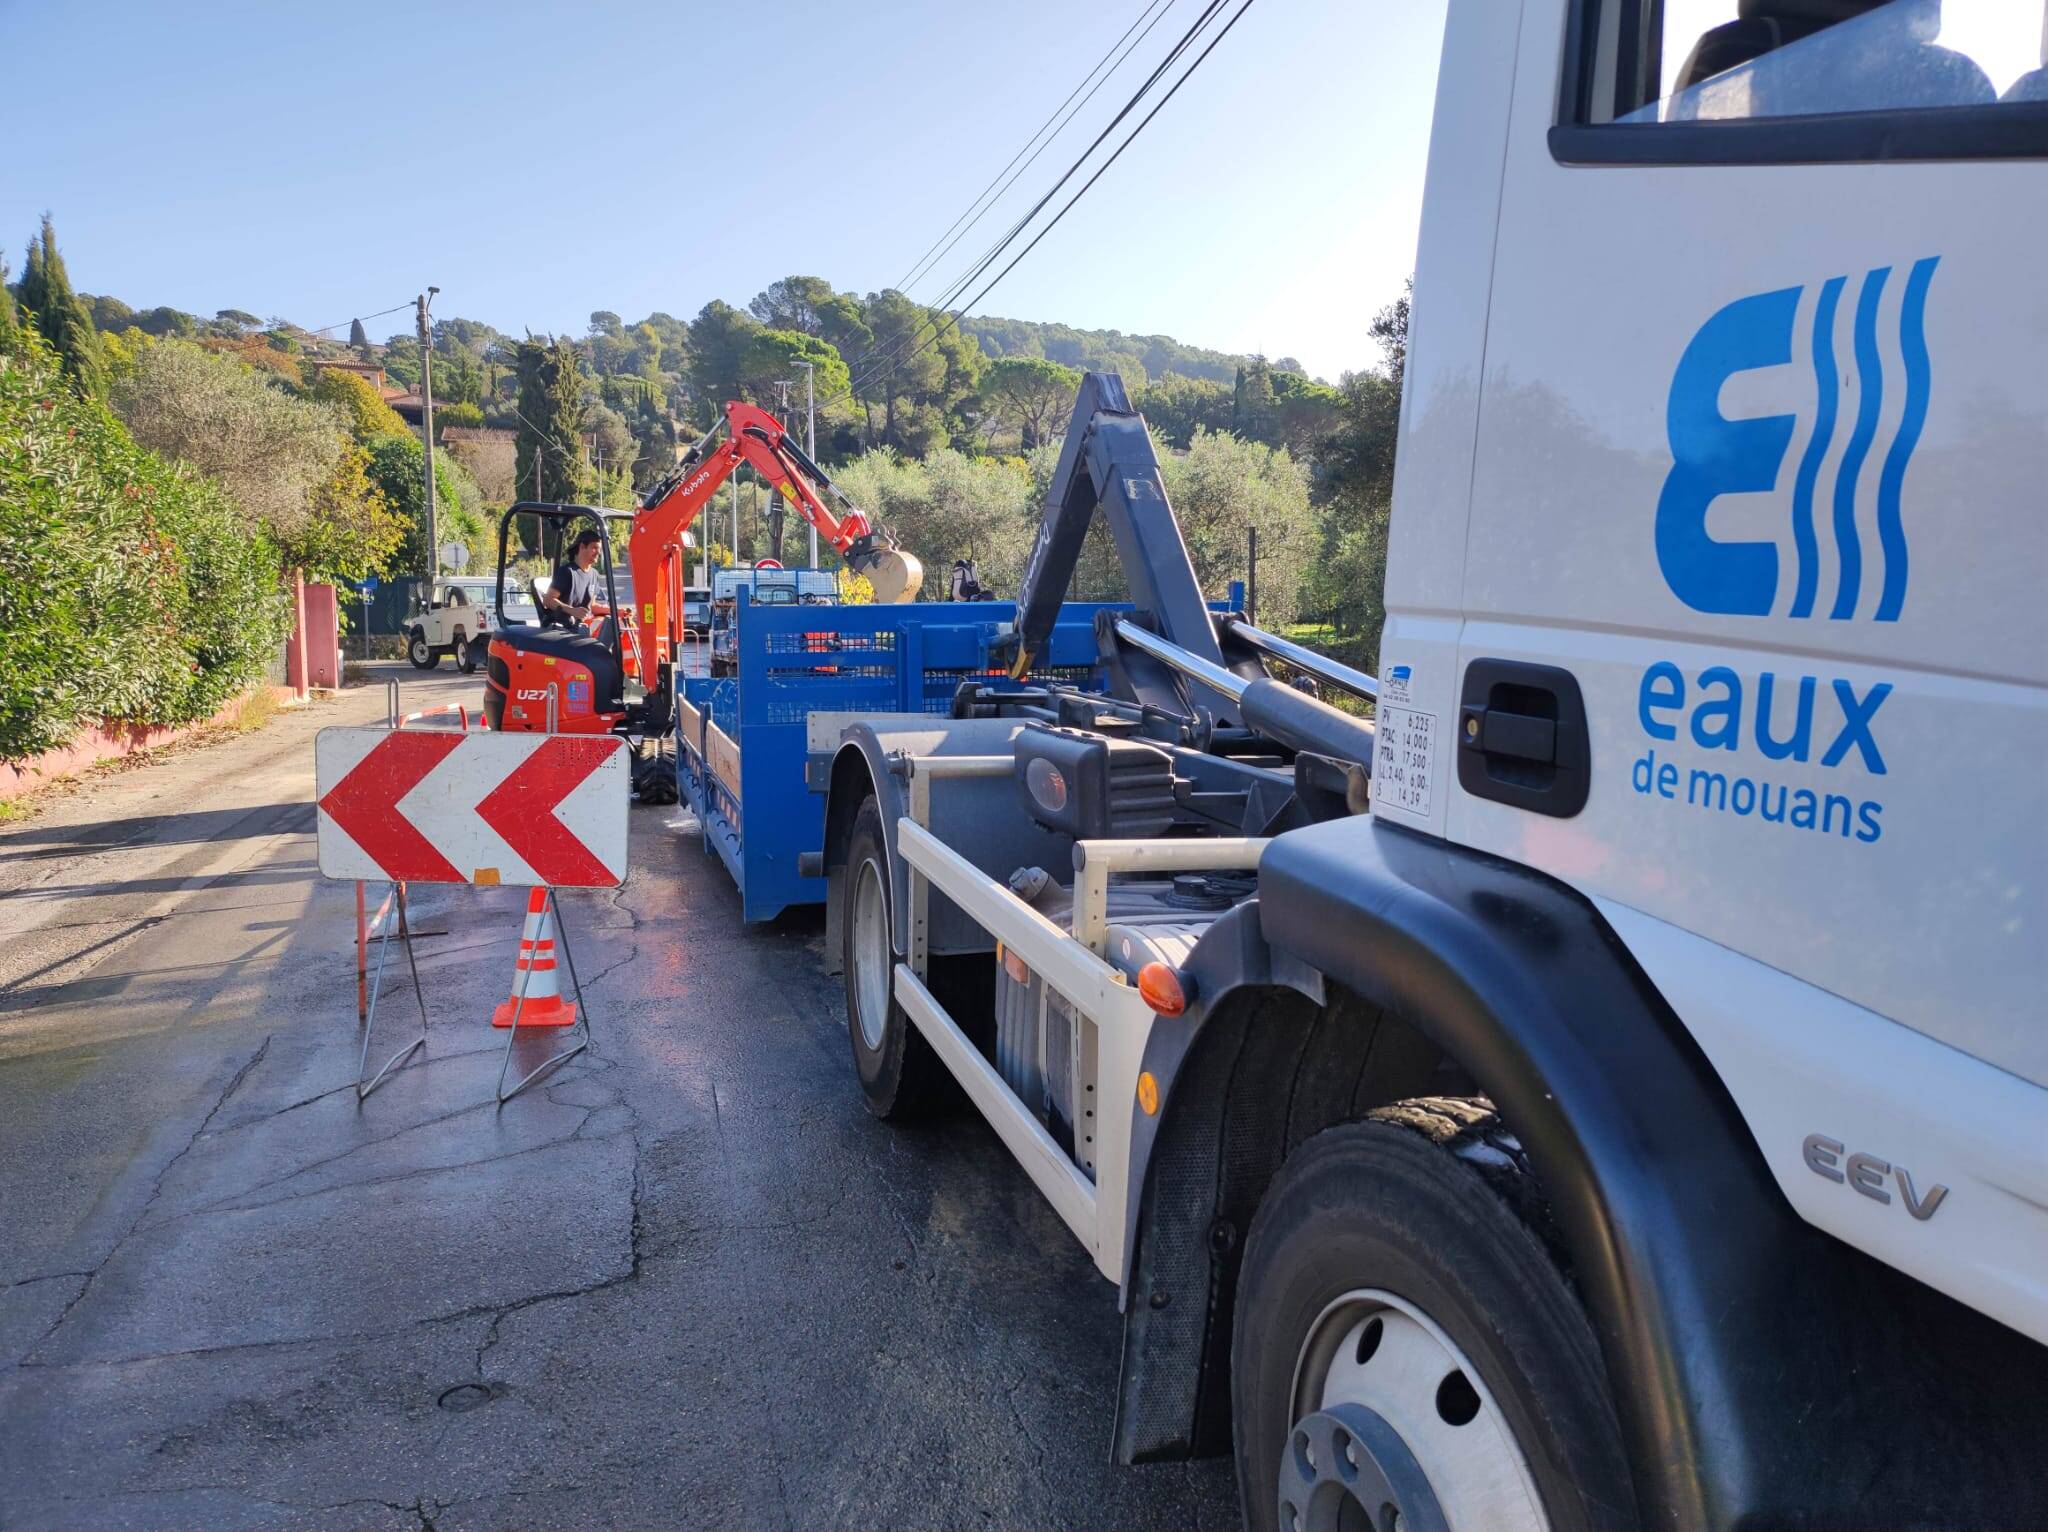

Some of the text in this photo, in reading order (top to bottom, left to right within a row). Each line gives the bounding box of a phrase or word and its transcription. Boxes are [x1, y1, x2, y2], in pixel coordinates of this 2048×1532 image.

[681, 471, 710, 497] Kubota
[1638, 660, 1894, 776] eaux
[1632, 749, 1883, 843] de mouans
[1802, 1133, 1949, 1221] EEV
